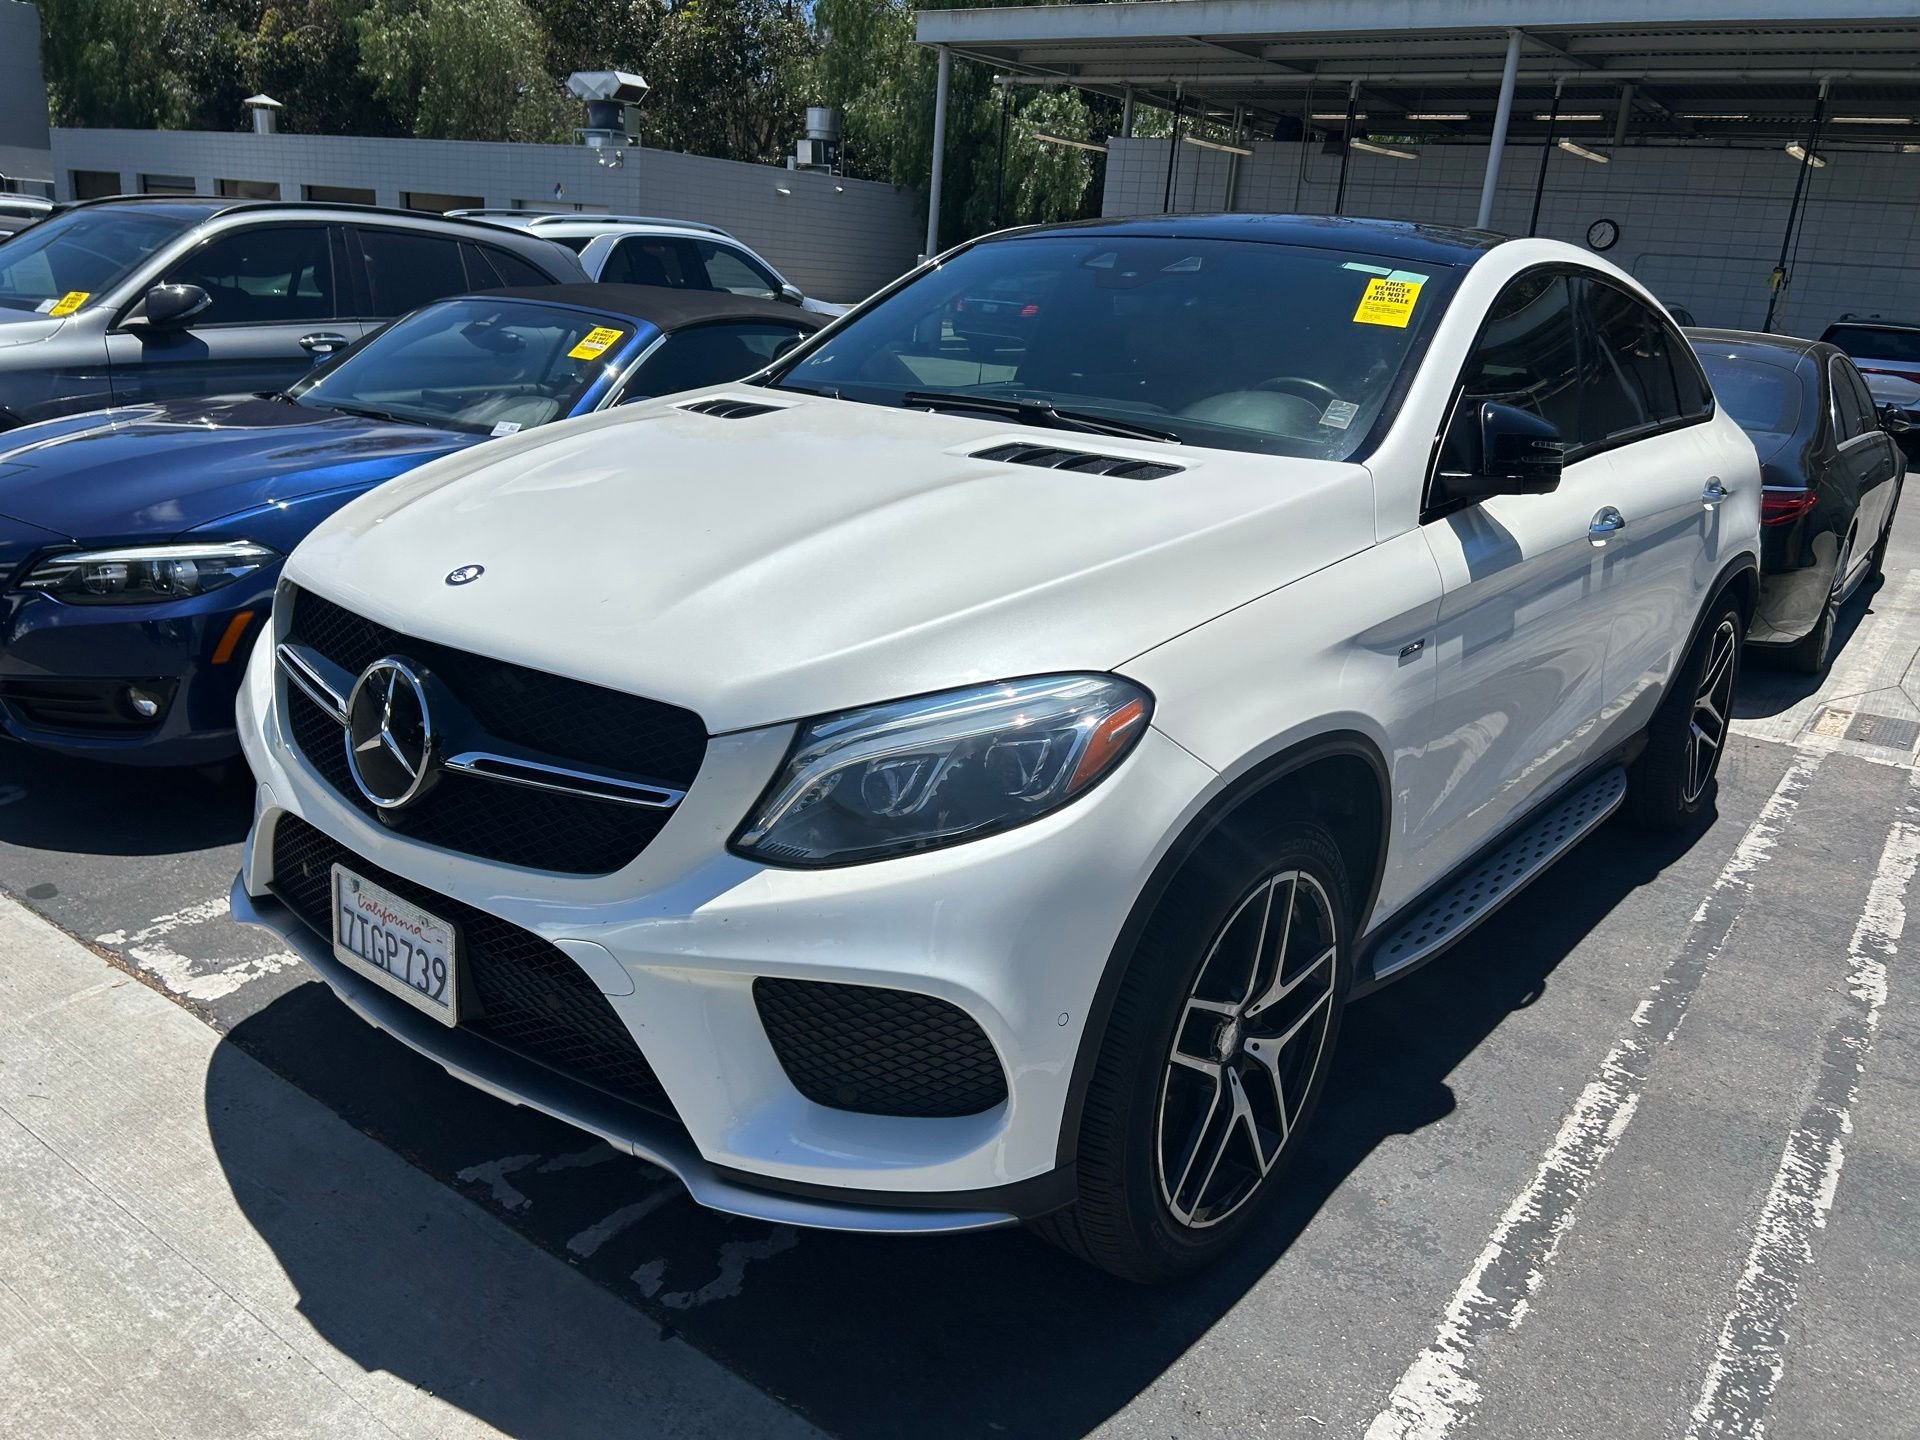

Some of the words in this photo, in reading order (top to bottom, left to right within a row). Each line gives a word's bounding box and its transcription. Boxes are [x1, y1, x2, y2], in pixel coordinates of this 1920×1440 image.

[1374, 285, 1412, 293] VEHICLE
[357, 893, 431, 944] California
[343, 906, 447, 1000] 7TGP739
